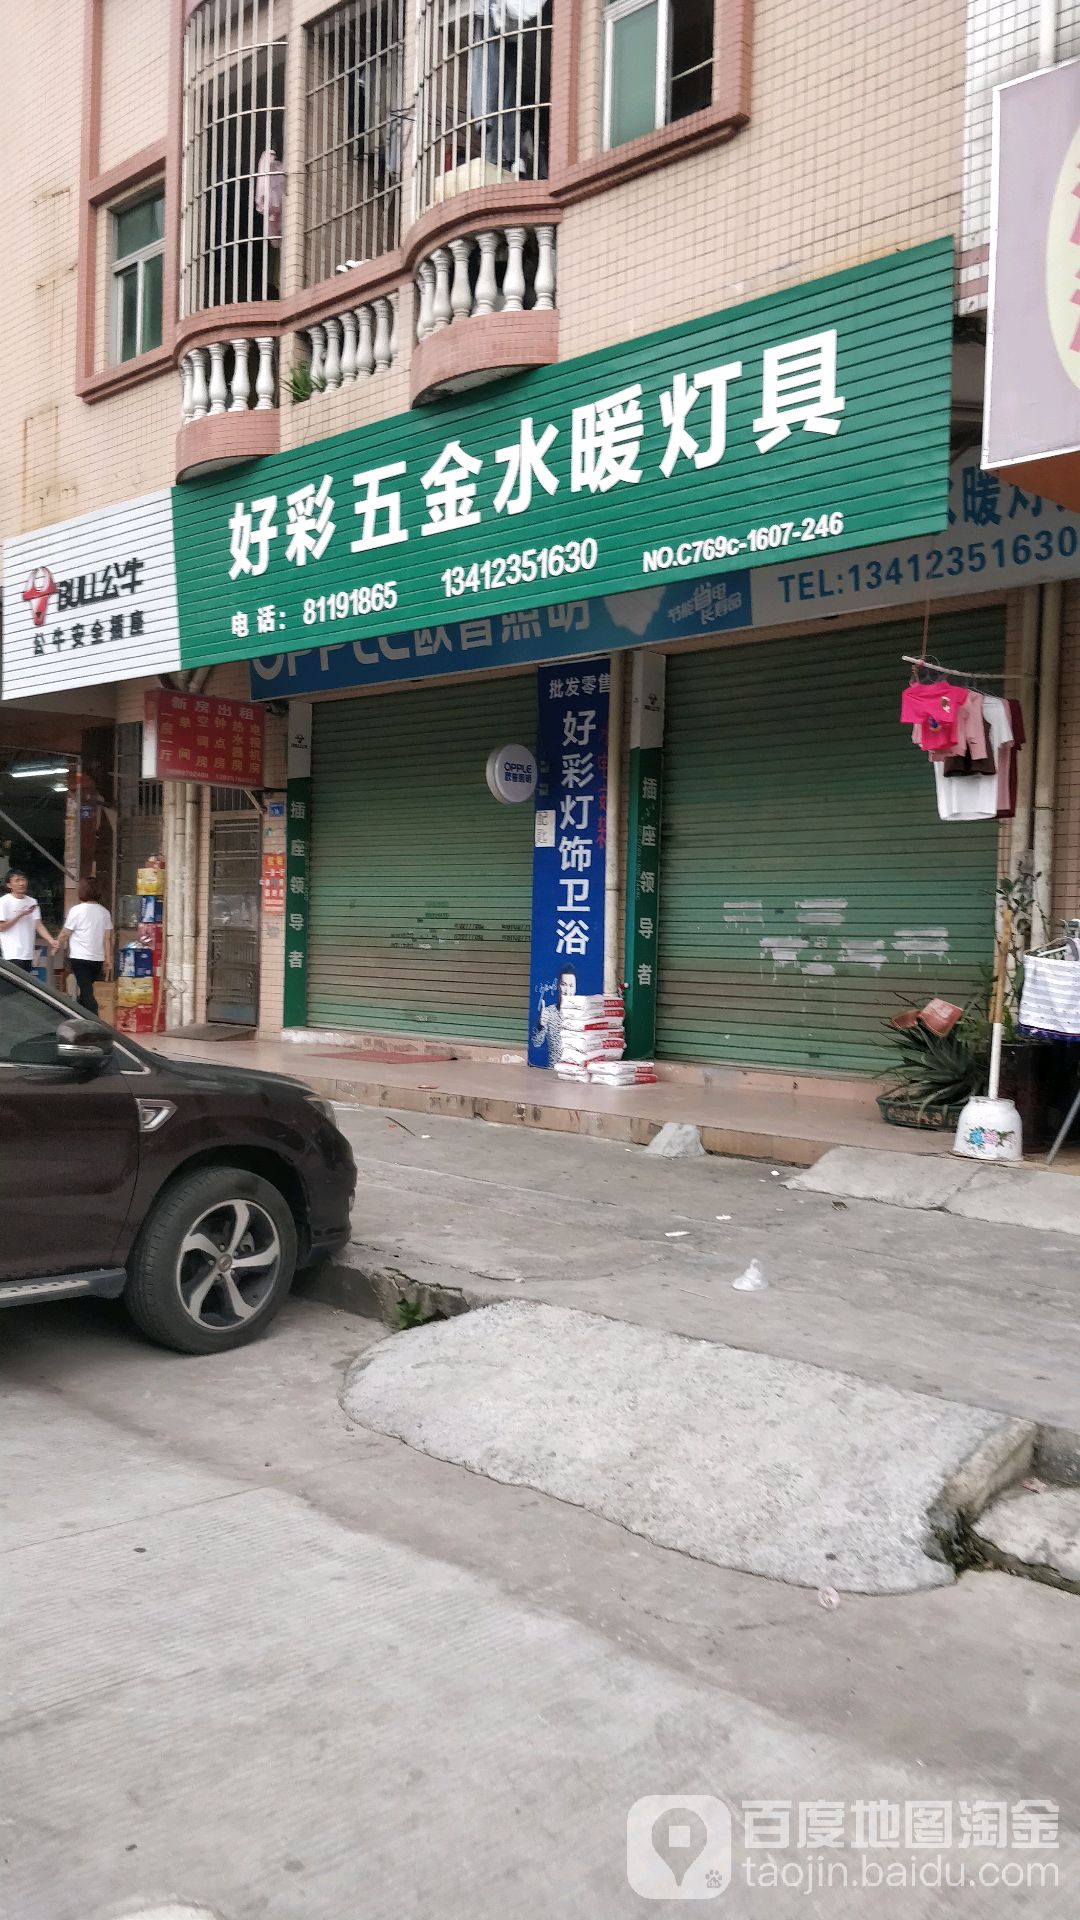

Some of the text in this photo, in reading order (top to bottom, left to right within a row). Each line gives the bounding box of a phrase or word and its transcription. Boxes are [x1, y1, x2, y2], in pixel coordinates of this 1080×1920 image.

[228, 329, 845, 580] 好彩五金水暖灯具
[302, 581, 398, 625] 81191865
[440, 537, 598, 598] 13412351630
[642, 511, 845, 573] NO.C769c-1607-246
[778, 526, 1077, 603] TEL:13412351630
[171, 696, 254, 720] 新房出租
[548, 674, 611, 699] 批发零售
[503, 762, 533, 774] OPPLE
[288, 801, 306, 970] 插座领导者
[555, 709, 598, 956] 好彩灯饰卫浴
[637, 776, 658, 986] 插座领导者
